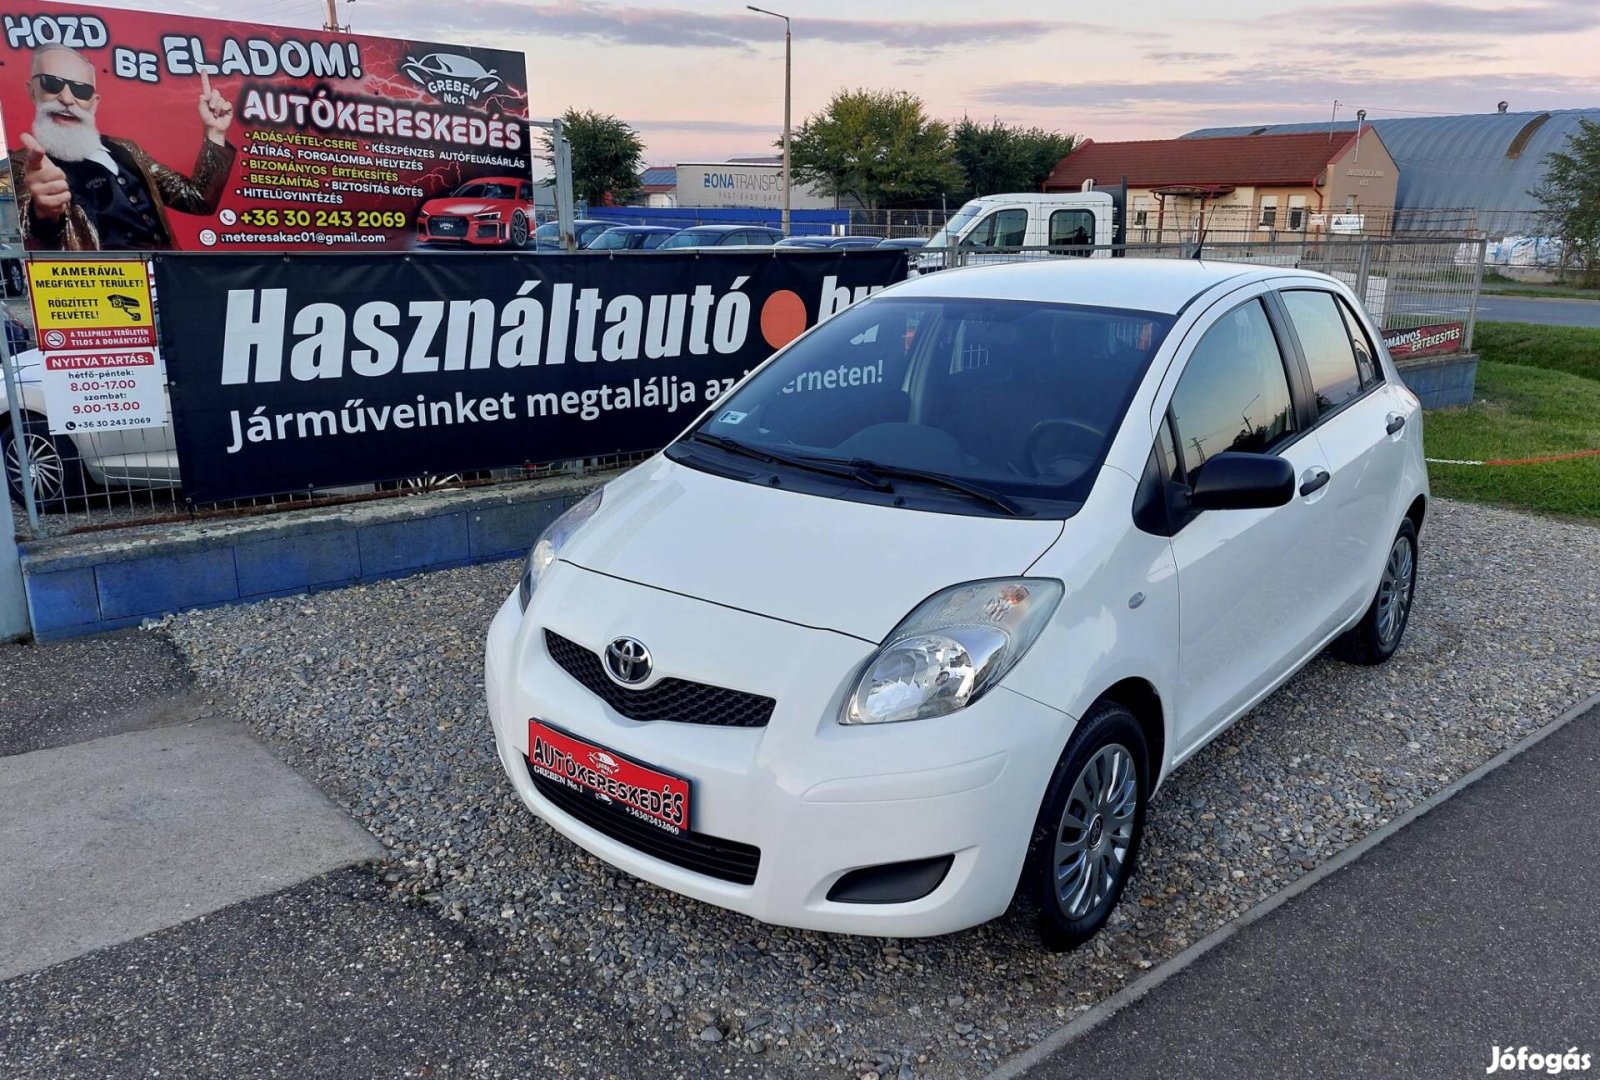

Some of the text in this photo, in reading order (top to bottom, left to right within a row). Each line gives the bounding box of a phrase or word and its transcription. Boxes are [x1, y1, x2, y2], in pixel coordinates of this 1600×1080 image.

[5, 16, 107, 47] HOZD
[163, 36, 361, 77] ELADOM!
[115, 48, 158, 82] BE
[428, 80, 479, 100] GREBEN
[443, 93, 465, 105] No.1
[243, 90, 521, 150] AUTÓKERESKEDÉS
[252, 131, 358, 151] ADÁS-VÉTEL-CSERE
[250, 143, 424, 171] ÁTÍRÁS, FORGALOMBA HELYEZÉS
[371, 143, 525, 169] KÉSZPÉNZES AUTÓFELVÁSÁRLÁS
[249, 159, 399, 182] BIZOMÁNYOS ÉRTÉKESÍTÉS
[250, 173, 320, 189] BESZÁMÍTÁS
[331, 181, 424, 197] BIZTOSÍTÁS KÖTÉS
[704, 172, 797, 192] BONATRANSPO
[243, 187, 343, 204] HITELÜGYINTÉZÉS
[240, 210, 406, 227] +36 30 243 2069
[52, 265, 126, 277] KAMERÁVAL
[36, 278, 144, 289] MEGFIGYELT TERÜLET!
[48, 297, 99, 308] RÖGZÍTETT
[51, 309, 99, 320] FELVÉTEL!
[78, 329, 112, 338] TELEPHELY
[71, 339, 93, 347] TILOS
[95, 338, 101, 346] A
[52, 352, 149, 368] NYITVA TARTÁS:
[68, 369, 135, 380] hétfő-péntek:
[70, 380, 136, 392] 8.00-17.00
[84, 393, 127, 401] szombat:
[72, 401, 140, 415] 9.00-13.00
[226, 391, 517, 454] Járműveinket
[527, 375, 696, 421] megtalálja
[110, 419, 128, 427] 243
[129, 417, 151, 426] 2069
[534, 765, 583, 793] GREBEN No.1
[534, 736, 683, 825] AUTÓKERESKEDÉS
